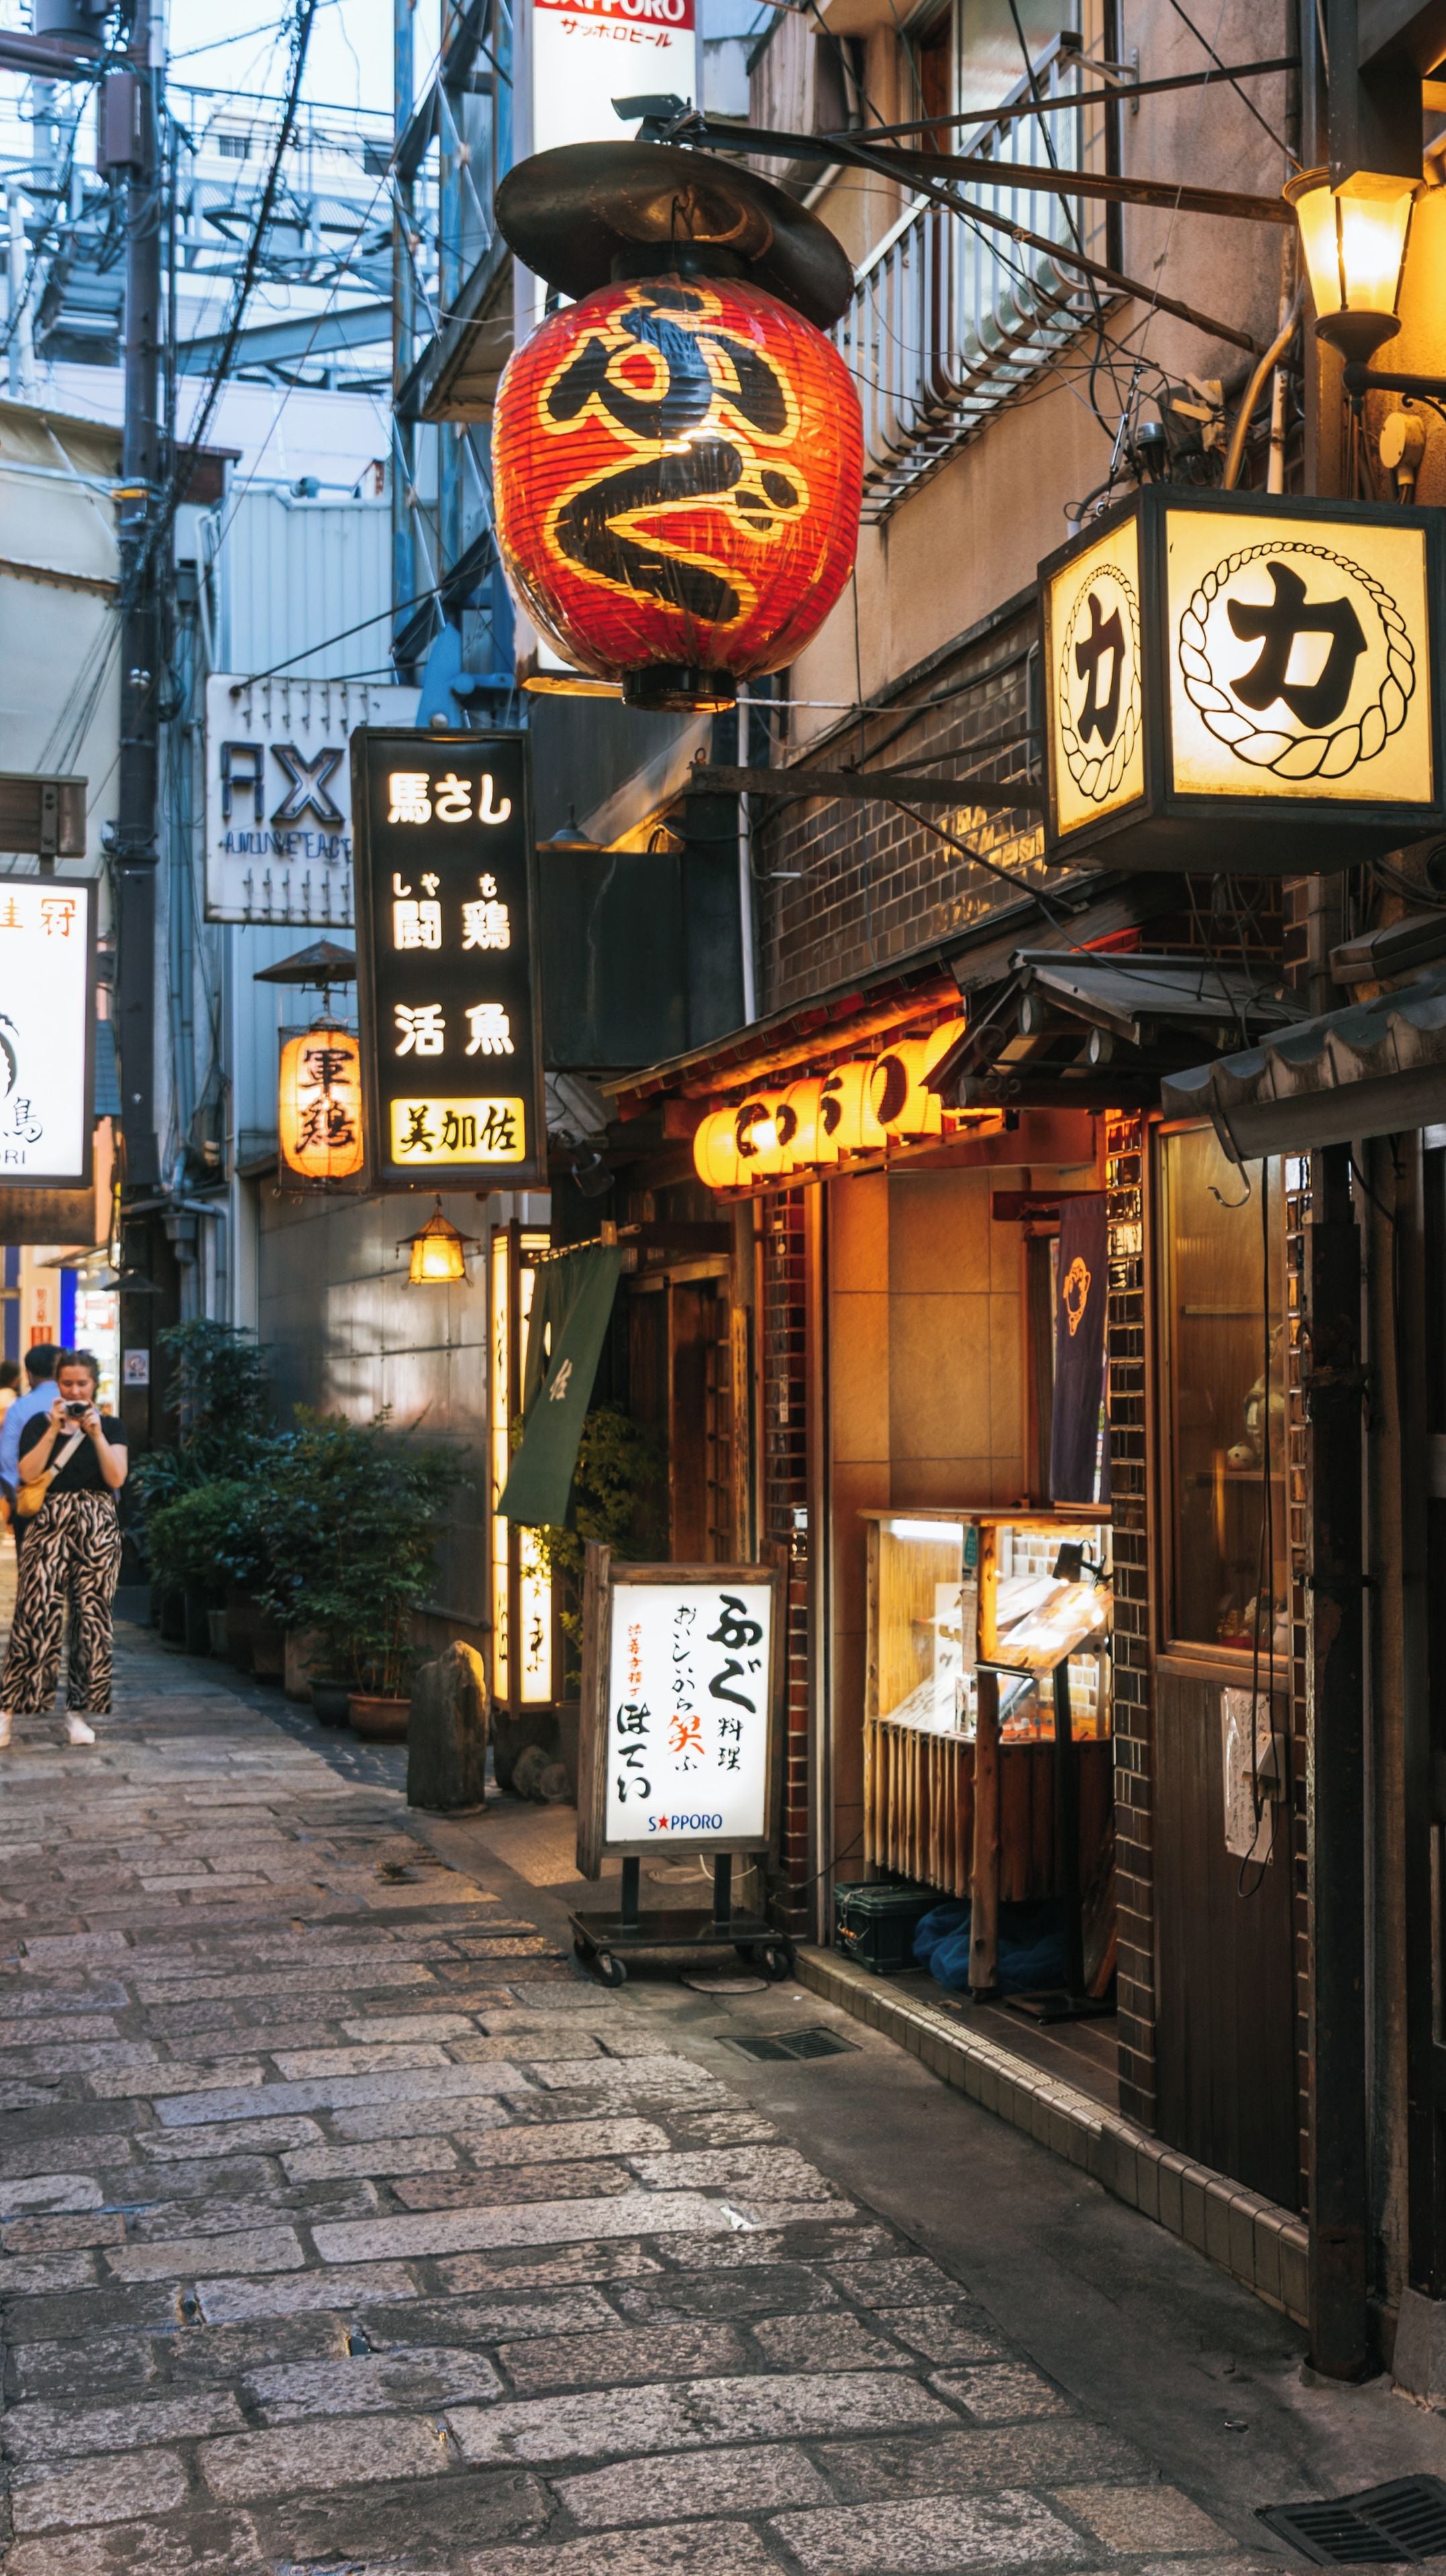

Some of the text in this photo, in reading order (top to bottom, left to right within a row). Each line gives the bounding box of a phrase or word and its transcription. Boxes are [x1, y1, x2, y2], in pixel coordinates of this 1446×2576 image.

[541, 0, 685, 21] PPORO
[387, 772, 511, 824] 馬さし
[394, 1003, 515, 1057] 活魚
[400, 1104, 517, 1154] 美加佐
[0, 1149, 26, 1165] RI
